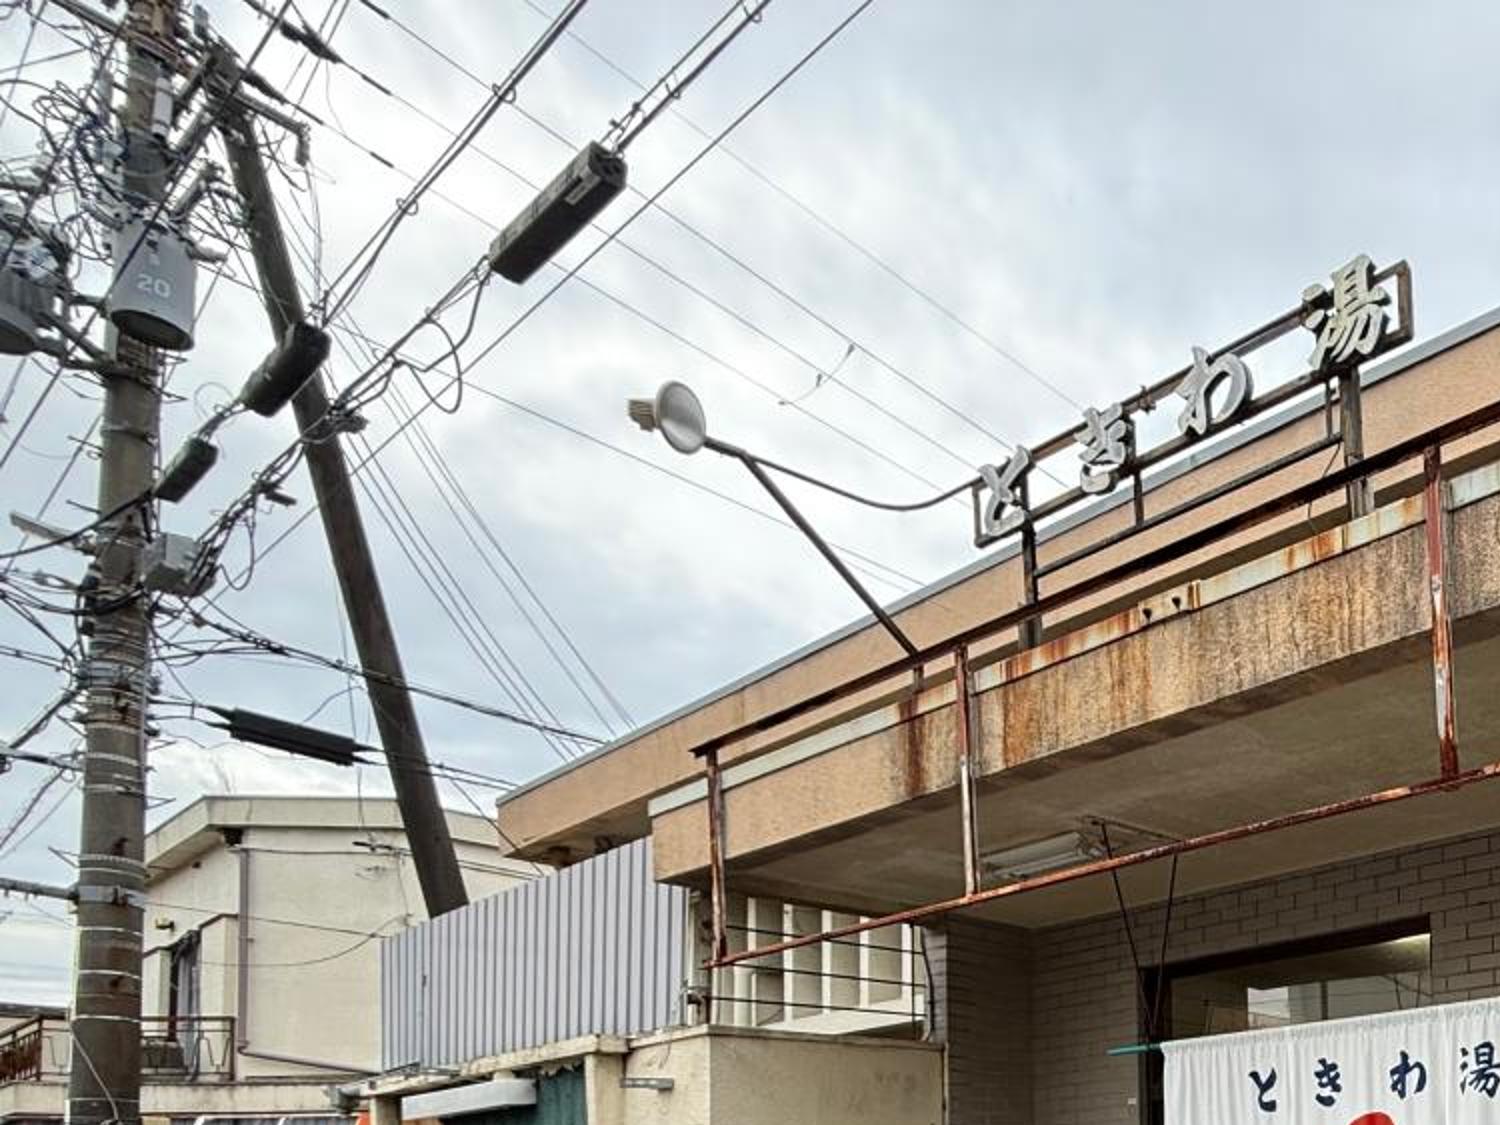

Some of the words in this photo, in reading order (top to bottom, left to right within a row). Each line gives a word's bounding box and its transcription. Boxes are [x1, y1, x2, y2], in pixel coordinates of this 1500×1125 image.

[137, 273, 171, 298] 20
[977, 253, 1391, 537] ときわ湯
